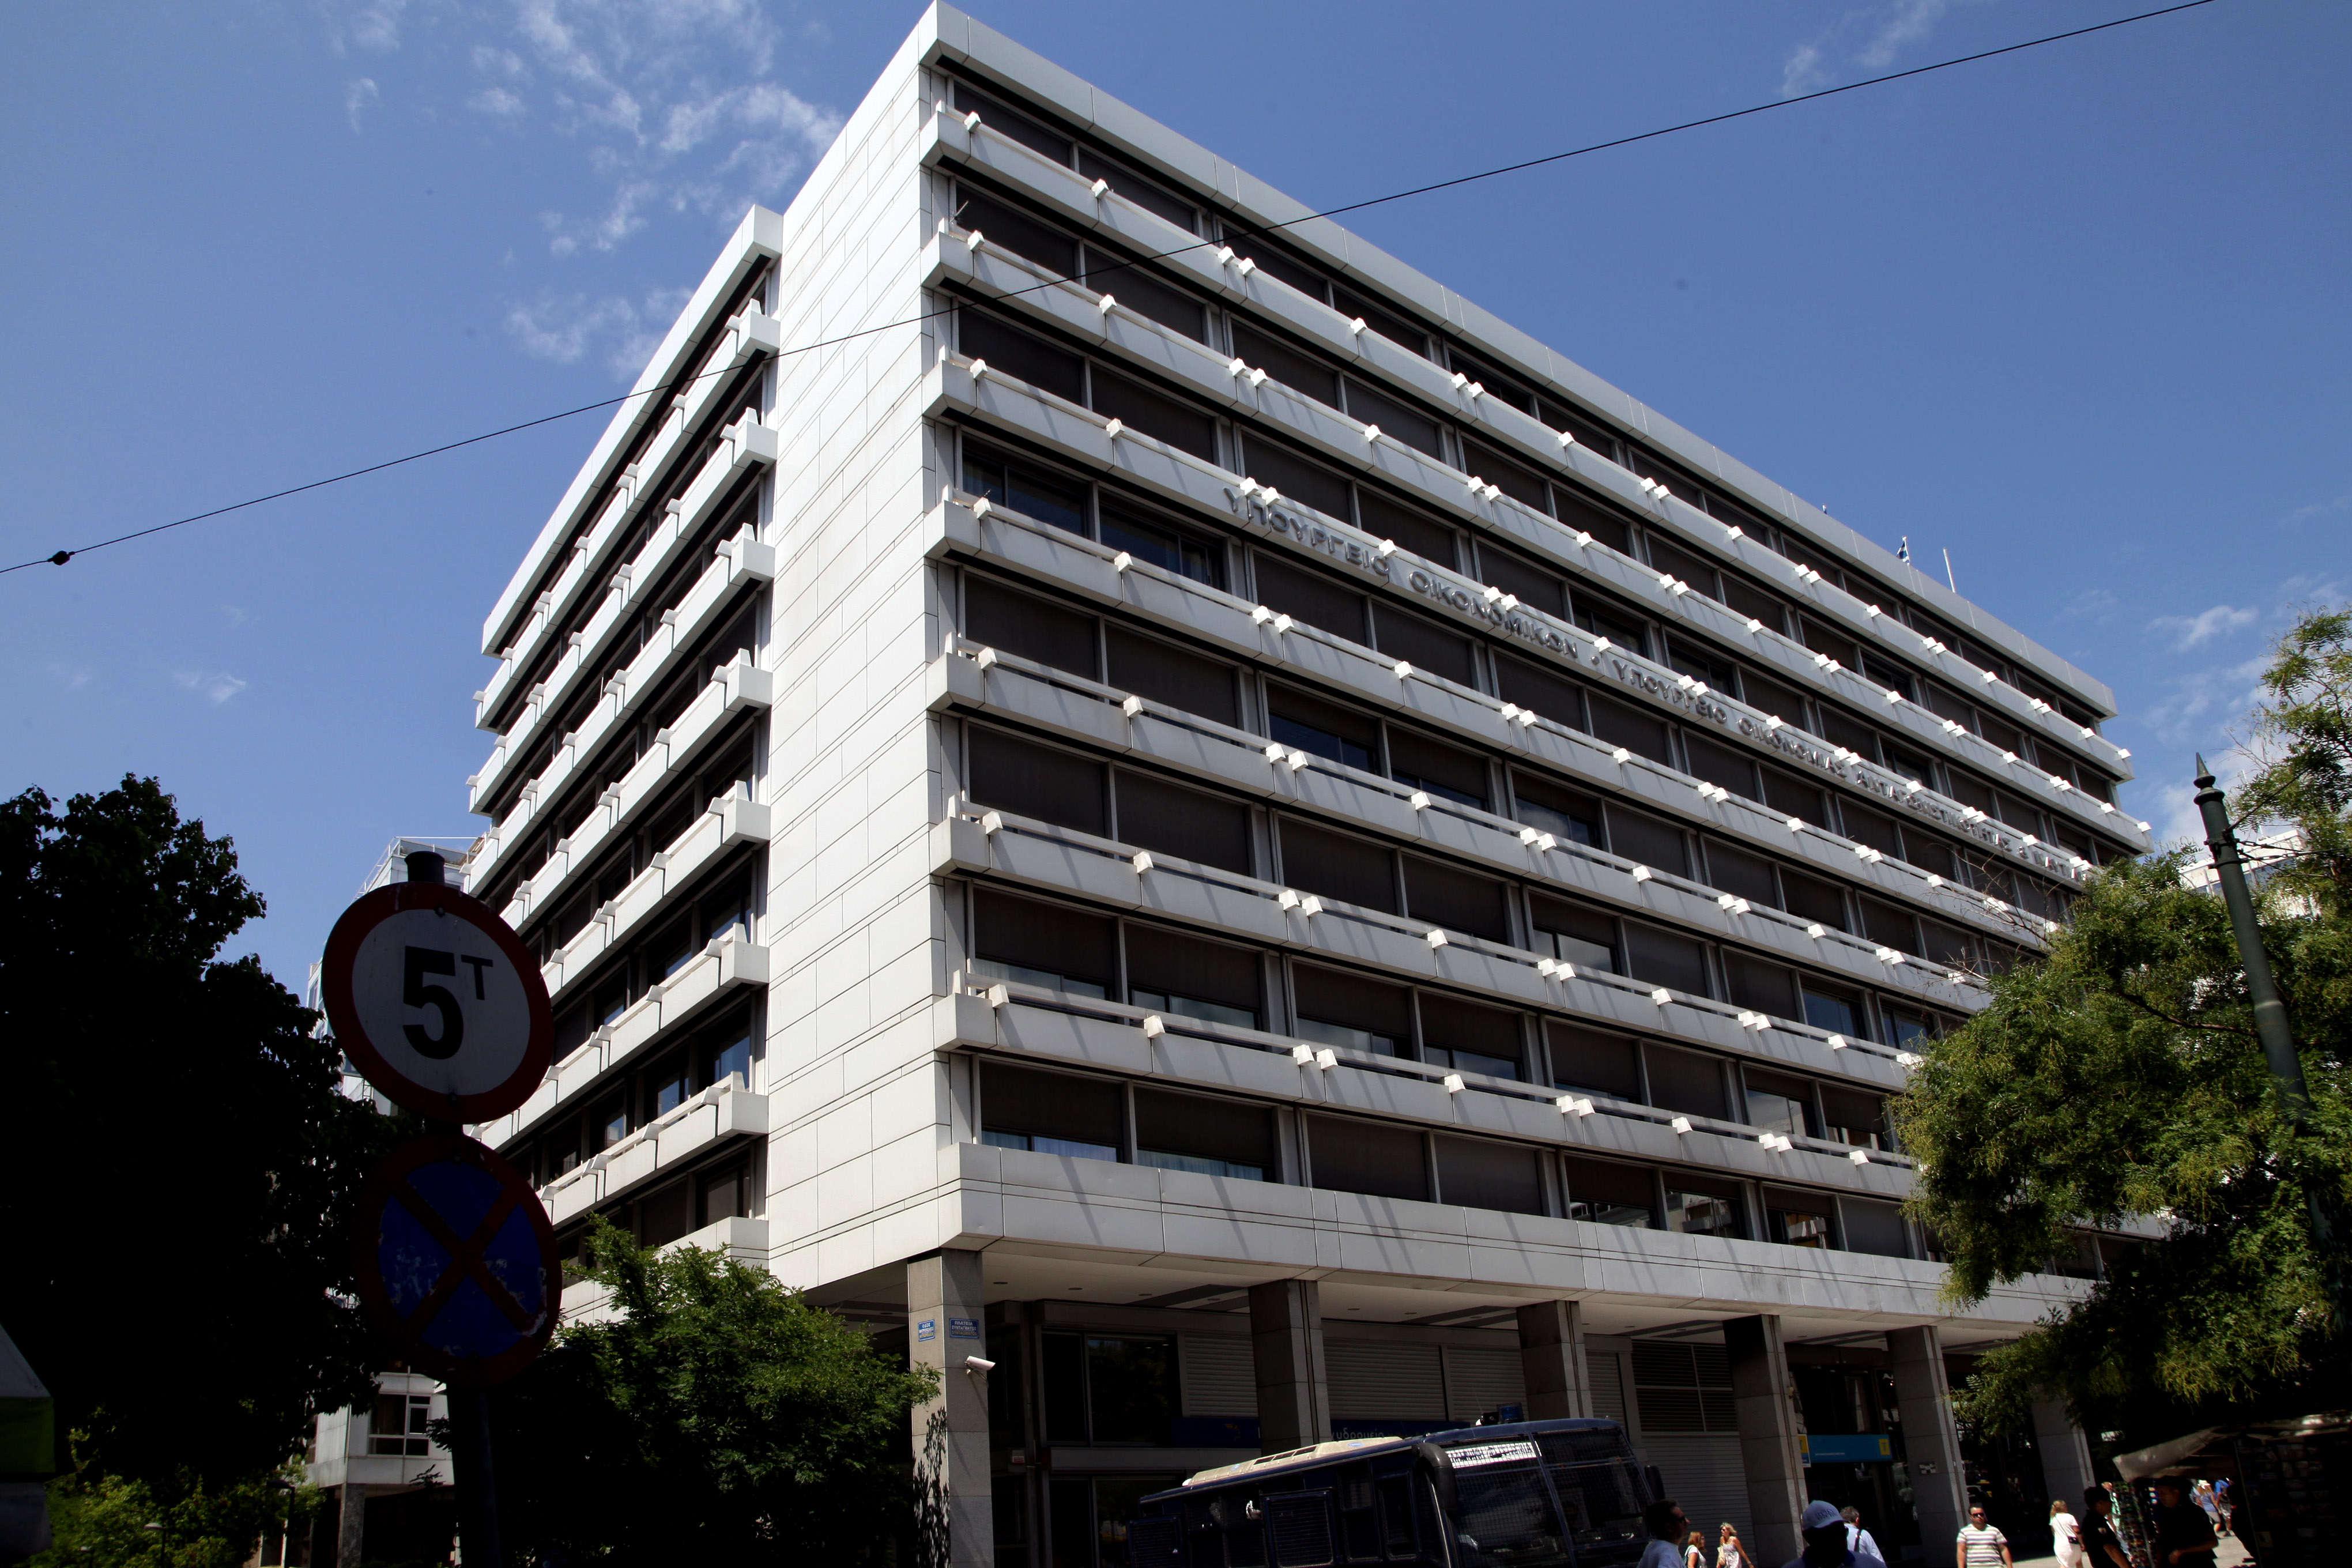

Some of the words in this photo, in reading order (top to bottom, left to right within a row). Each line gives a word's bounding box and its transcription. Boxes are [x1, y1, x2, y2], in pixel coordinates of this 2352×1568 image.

[1223, 487, 1391, 575] ΥΠΟΥΡΓΕΙΟ
[1408, 571, 1578, 658] ΟΙΚΟΝΟΜΙΚΩΝ
[1612, 659, 1727, 724] ΥΠΟΥΡΓΕΙΟ
[1737, 717, 1847, 778] ΟΙΚΟΝΟΜΙΑΣ
[2016, 846, 2029, 859] &
